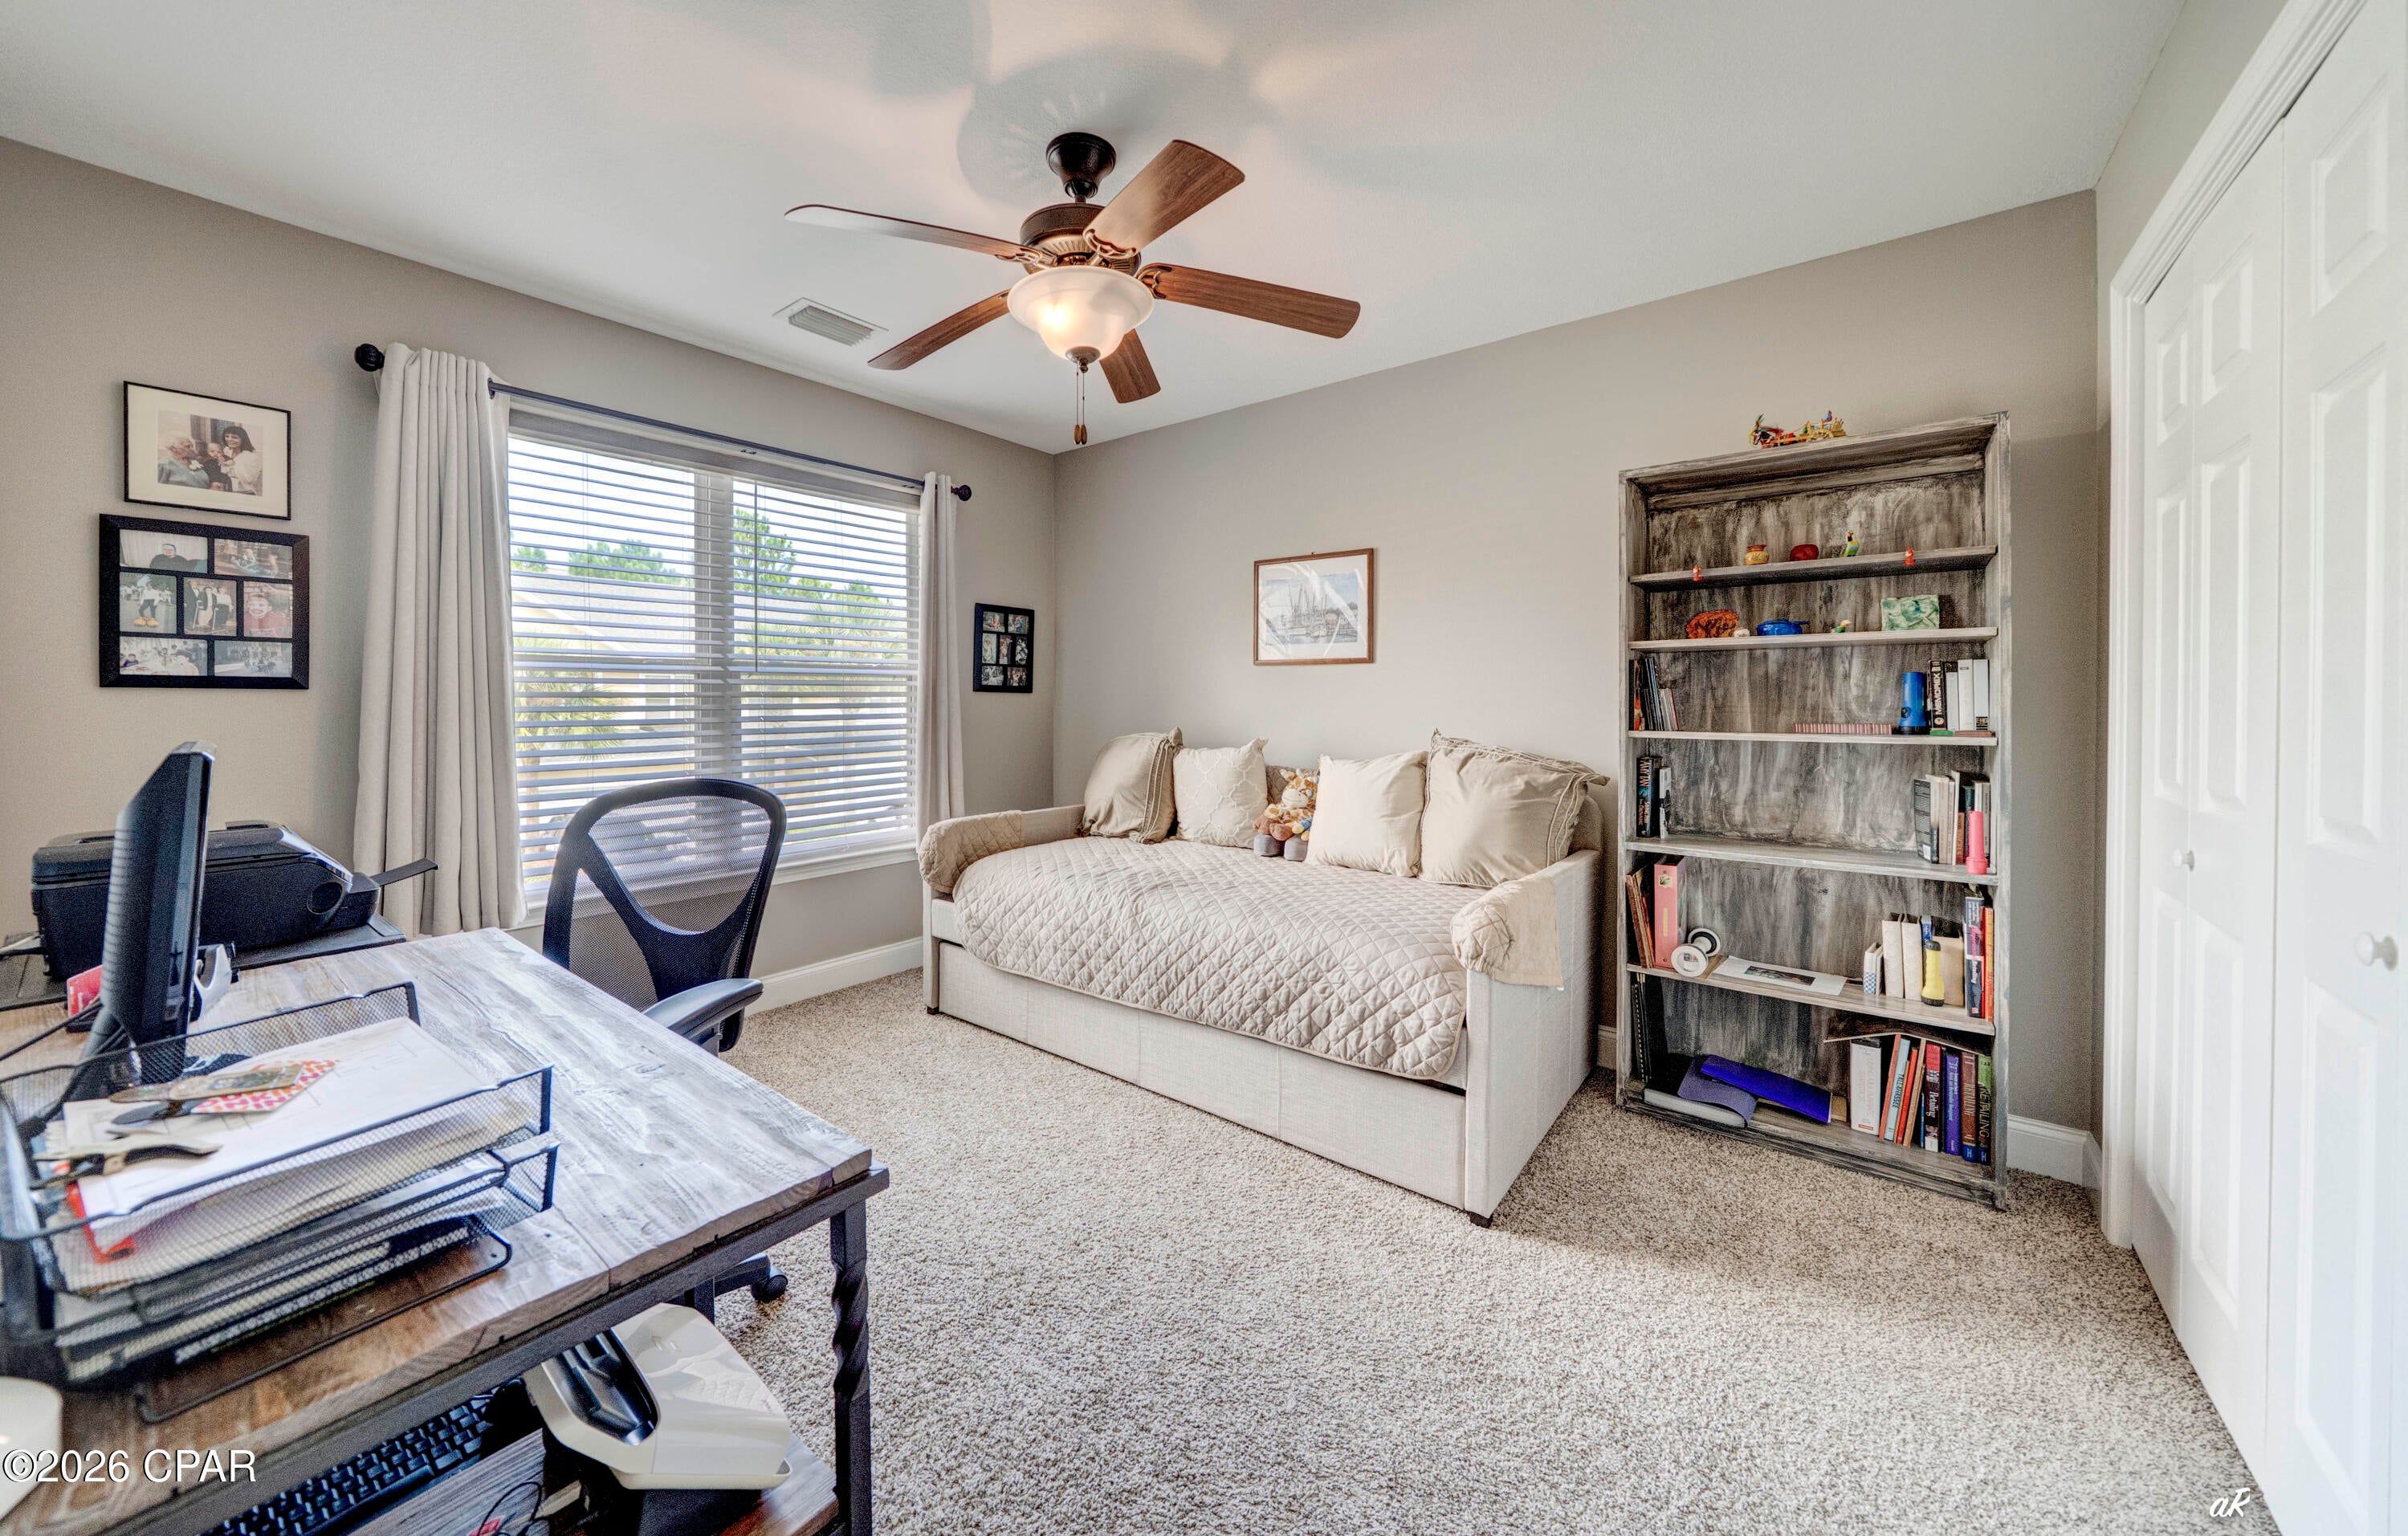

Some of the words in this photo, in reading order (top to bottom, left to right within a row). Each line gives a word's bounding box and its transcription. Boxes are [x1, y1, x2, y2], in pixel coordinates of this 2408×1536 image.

[1933, 673, 1942, 715] MEMOREX
[1640, 760, 1650, 775] AMY
[1640, 774, 1650, 787] TAN
[1926, 1091, 1939, 1118] Retailing
[1963, 1082, 1976, 1117] RETAILING
[1979, 1087, 1990, 1138] RETAILING
